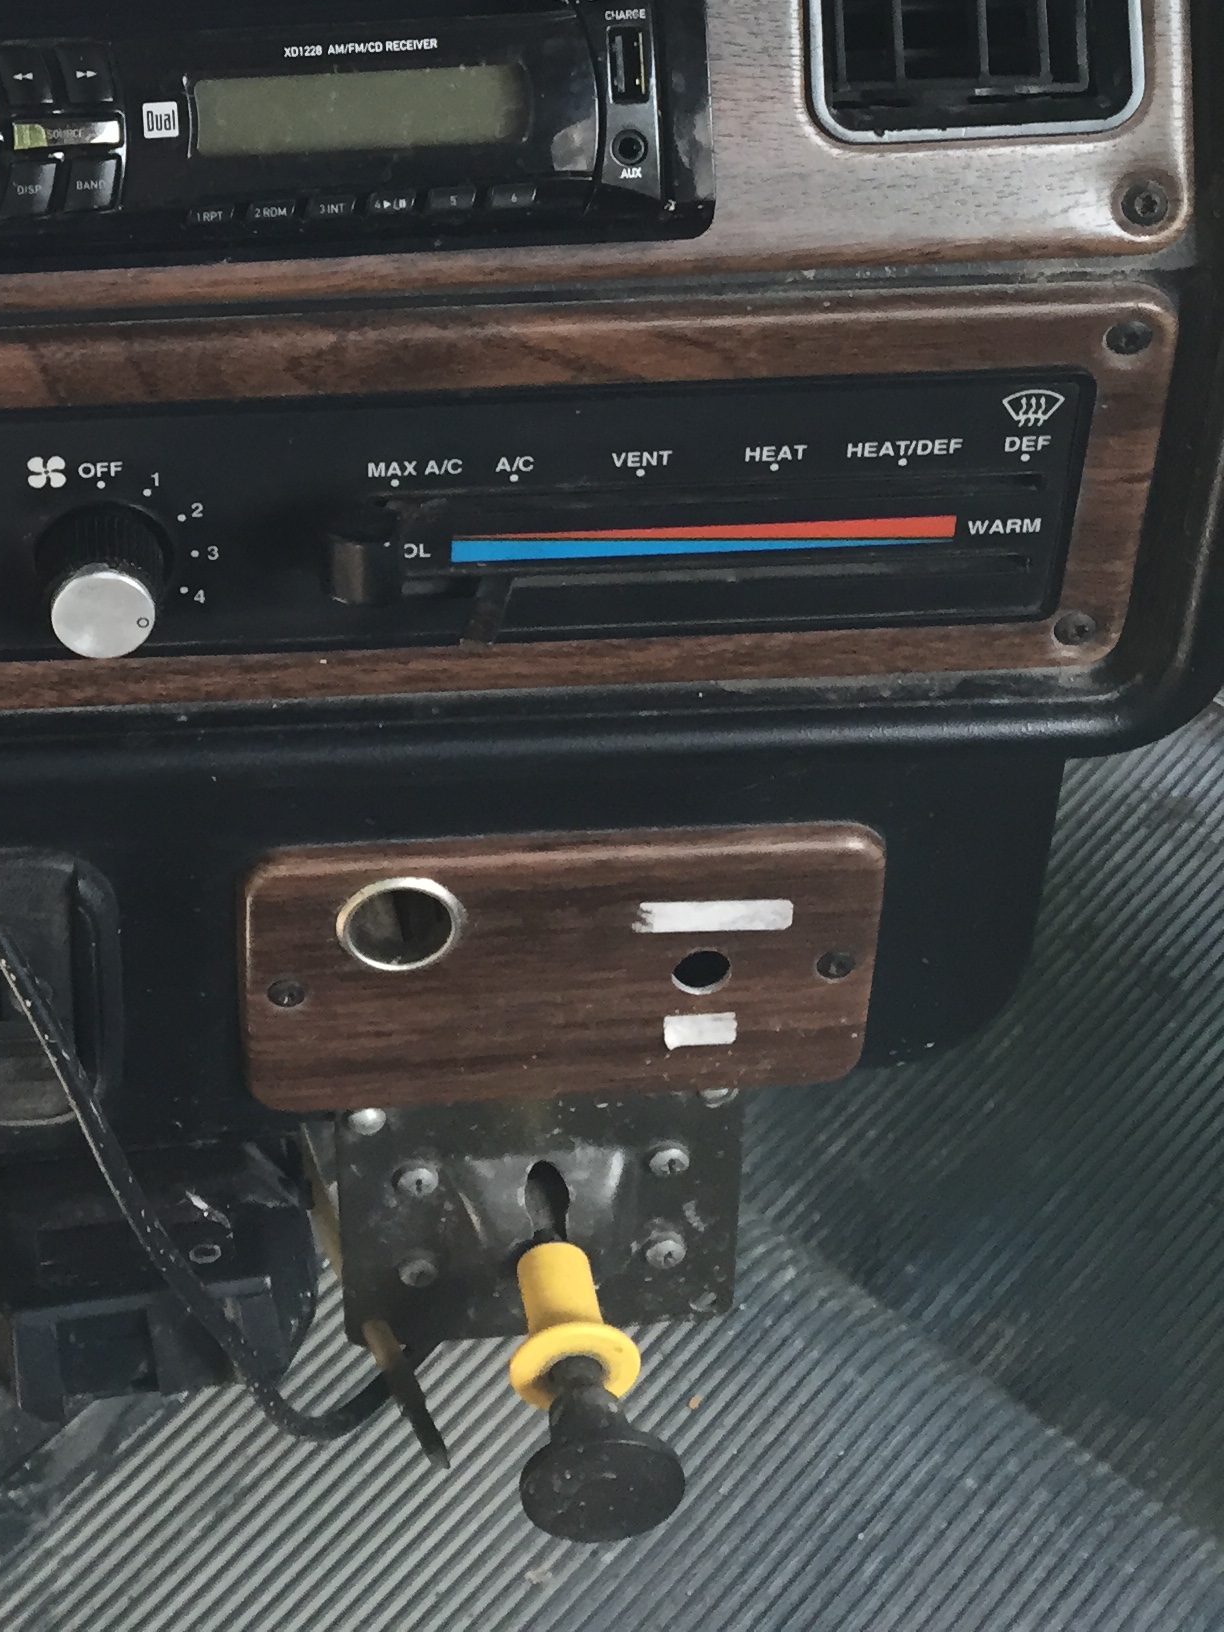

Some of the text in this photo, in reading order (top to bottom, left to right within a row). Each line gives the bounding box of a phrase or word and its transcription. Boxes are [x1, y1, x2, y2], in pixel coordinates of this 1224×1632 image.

[605, 8, 646, 21] CHARGE
[327, 42, 383, 55] AM/FM/CD
[385, 38, 438, 52] RECEIVER
[146, 109, 176, 132] Dual
[46, 128, 84, 139] SOURCE
[620, 167, 642, 179] AUX
[17, 184, 42, 195] DISP
[76, 180, 105, 191] BAND
[847, 438, 963, 459] HEAT/DEF
[1004, 435, 1051, 453] DEF
[612, 450, 672, 467] VENT
[744, 445, 807, 463] HEAT
[78, 461, 123, 478] OFF
[367, 458, 463, 477] MAX A/C
[495, 456, 535, 472] A/C
[151, 472, 160, 487] 1
[191, 502, 204, 518] 2
[968, 518, 1042, 535] WARM
[207, 545, 219, 560] 3
[193, 589, 206, 604] 4
